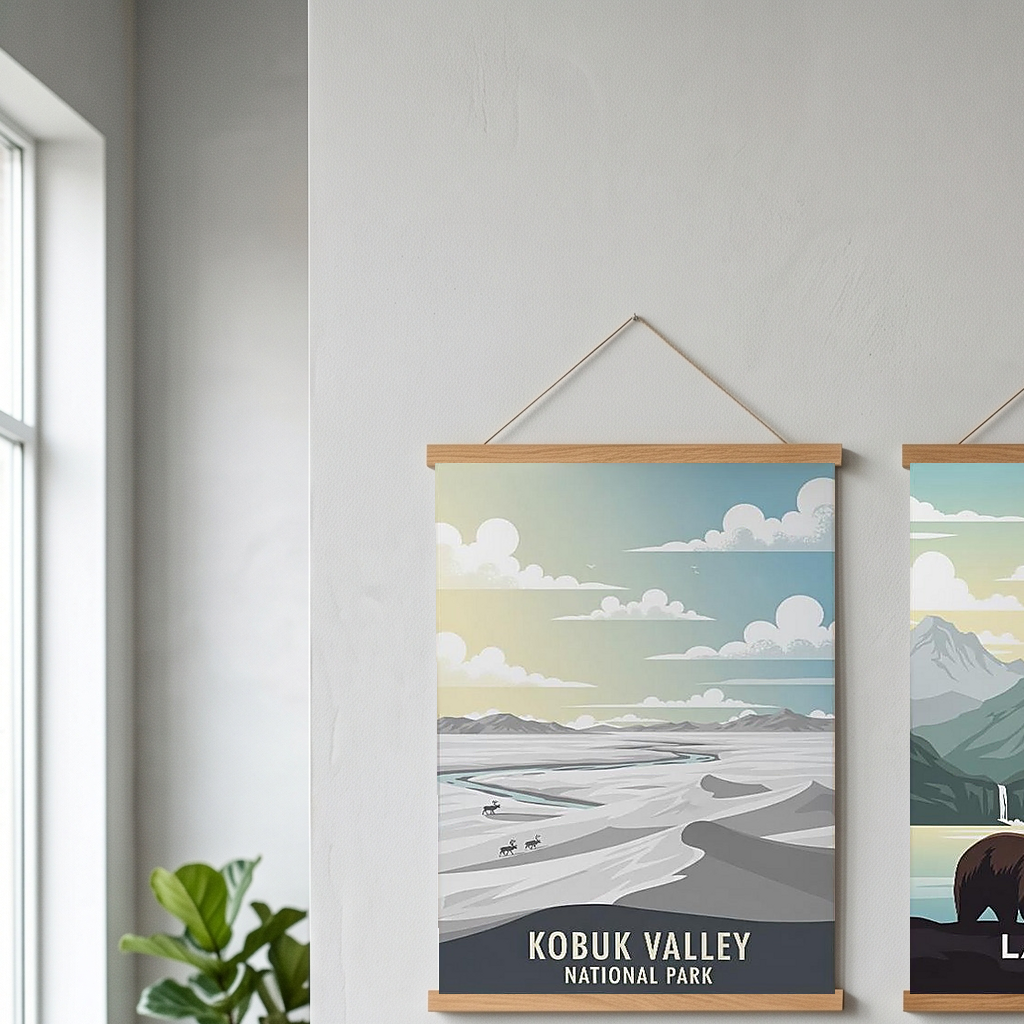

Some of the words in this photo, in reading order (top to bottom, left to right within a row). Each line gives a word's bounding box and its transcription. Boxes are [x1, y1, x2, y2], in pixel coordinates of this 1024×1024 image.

[528, 930, 633, 961] KOBUK
[643, 930, 751, 961] VALLEY
[564, 966, 659, 985] NATIONAL
[666, 966, 714, 985] PARK
